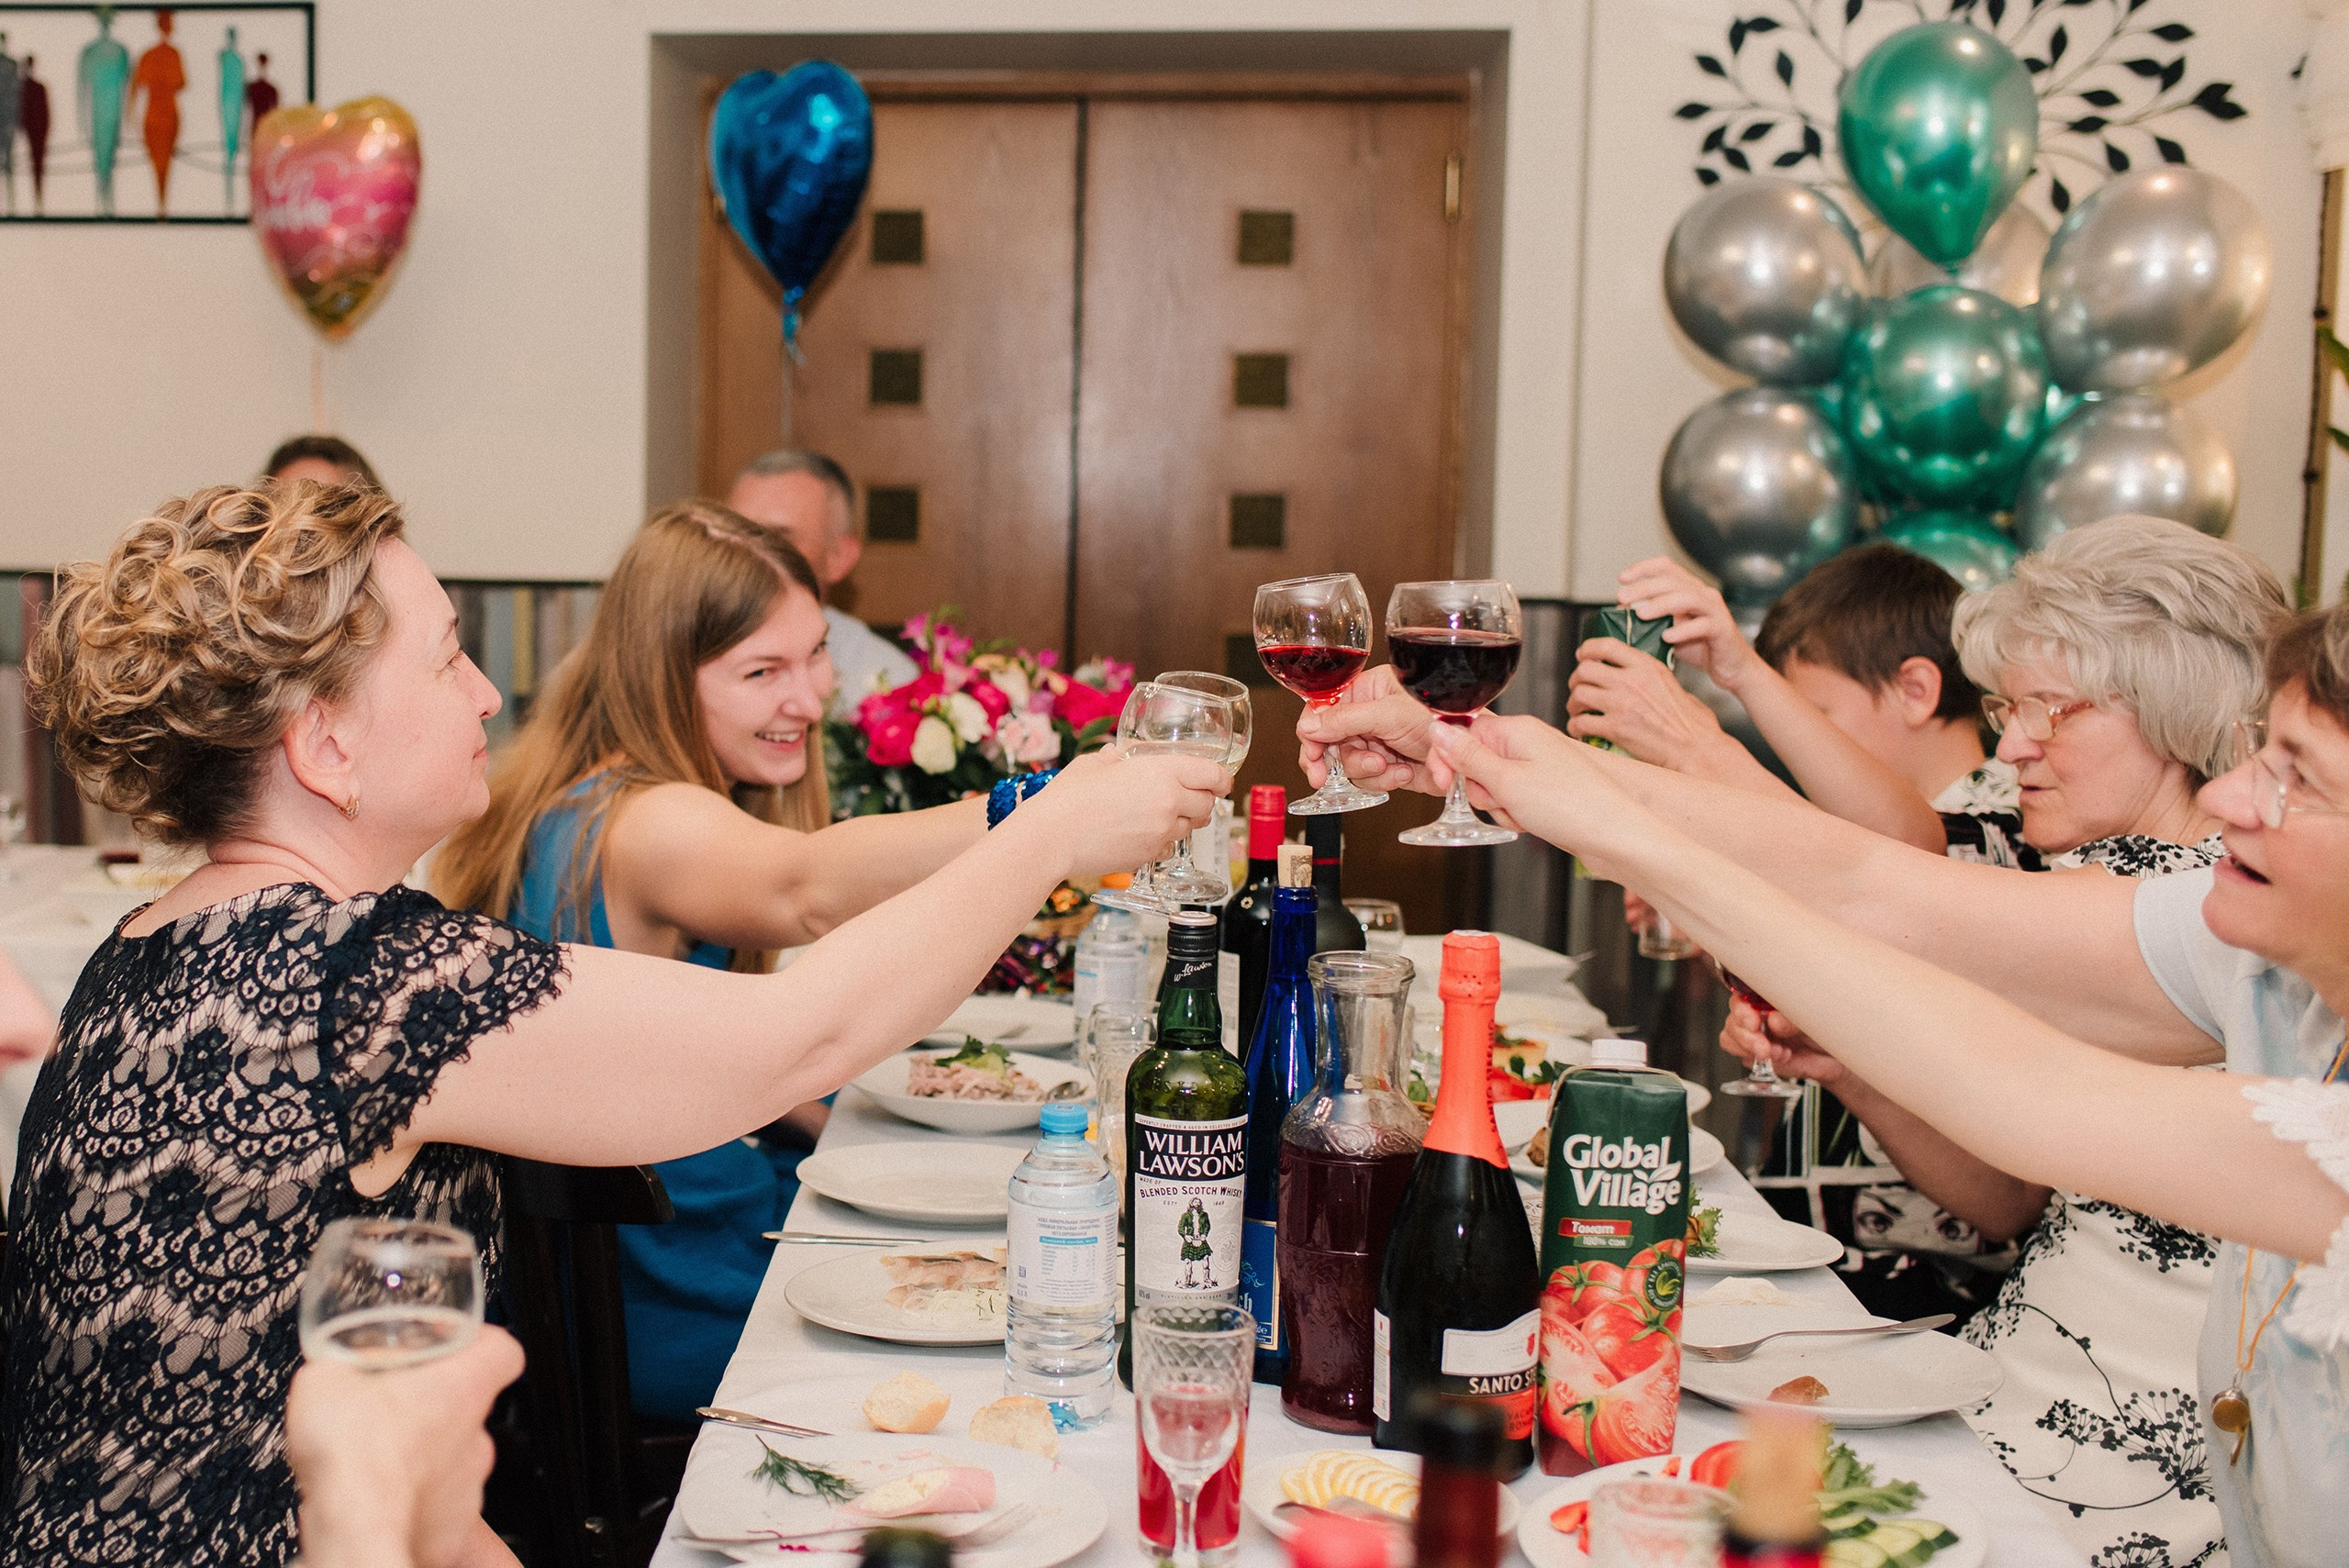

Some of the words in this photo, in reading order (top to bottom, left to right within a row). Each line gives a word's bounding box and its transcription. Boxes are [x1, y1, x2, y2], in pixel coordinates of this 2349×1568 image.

[1144, 1129, 1242, 1155] WILLIAM
[1563, 1133, 1672, 1169] Global
[1139, 1150, 1245, 1177] LAWSON'S
[1139, 1176, 1152, 1184] MADE
[1140, 1187, 1178, 1198] BLENDED
[1182, 1185, 1218, 1195] SCOTCH
[1219, 1186, 1243, 1198] WHISKY
[1570, 1168, 1682, 1216] Village
[1468, 1373, 1523, 1395] SANTO
